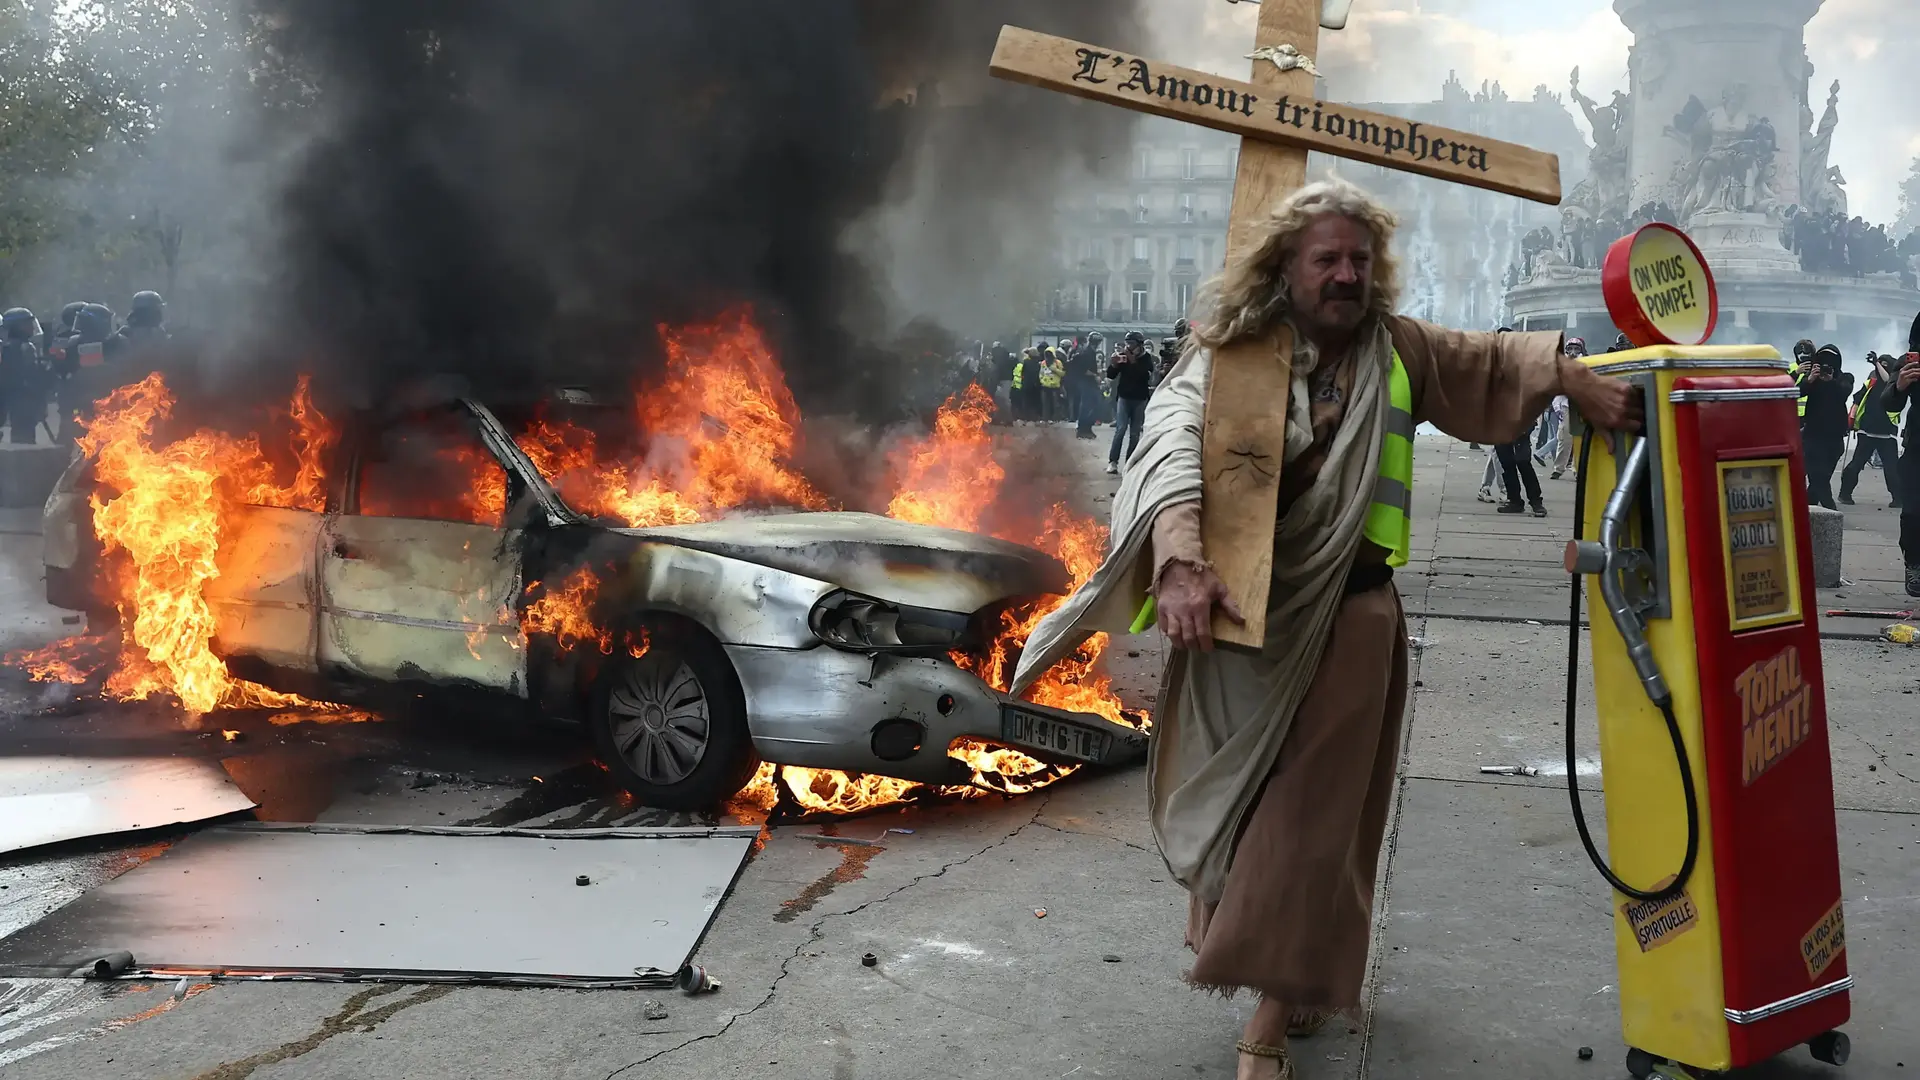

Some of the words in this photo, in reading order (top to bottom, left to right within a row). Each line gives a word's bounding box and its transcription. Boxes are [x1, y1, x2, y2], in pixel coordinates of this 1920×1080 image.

[1072, 48, 1258, 117] L'Amour
[1274, 95, 1491, 172] triomphera
[1634, 265, 1653, 292] ON
[1650, 254, 1686, 286] VOUS
[1645, 280, 1697, 321] POMPE!
[1735, 647, 1801, 726] TOTAL
[1743, 684, 1811, 783] MENT!
[1639, 901, 1694, 944] SPIRITUELLE
